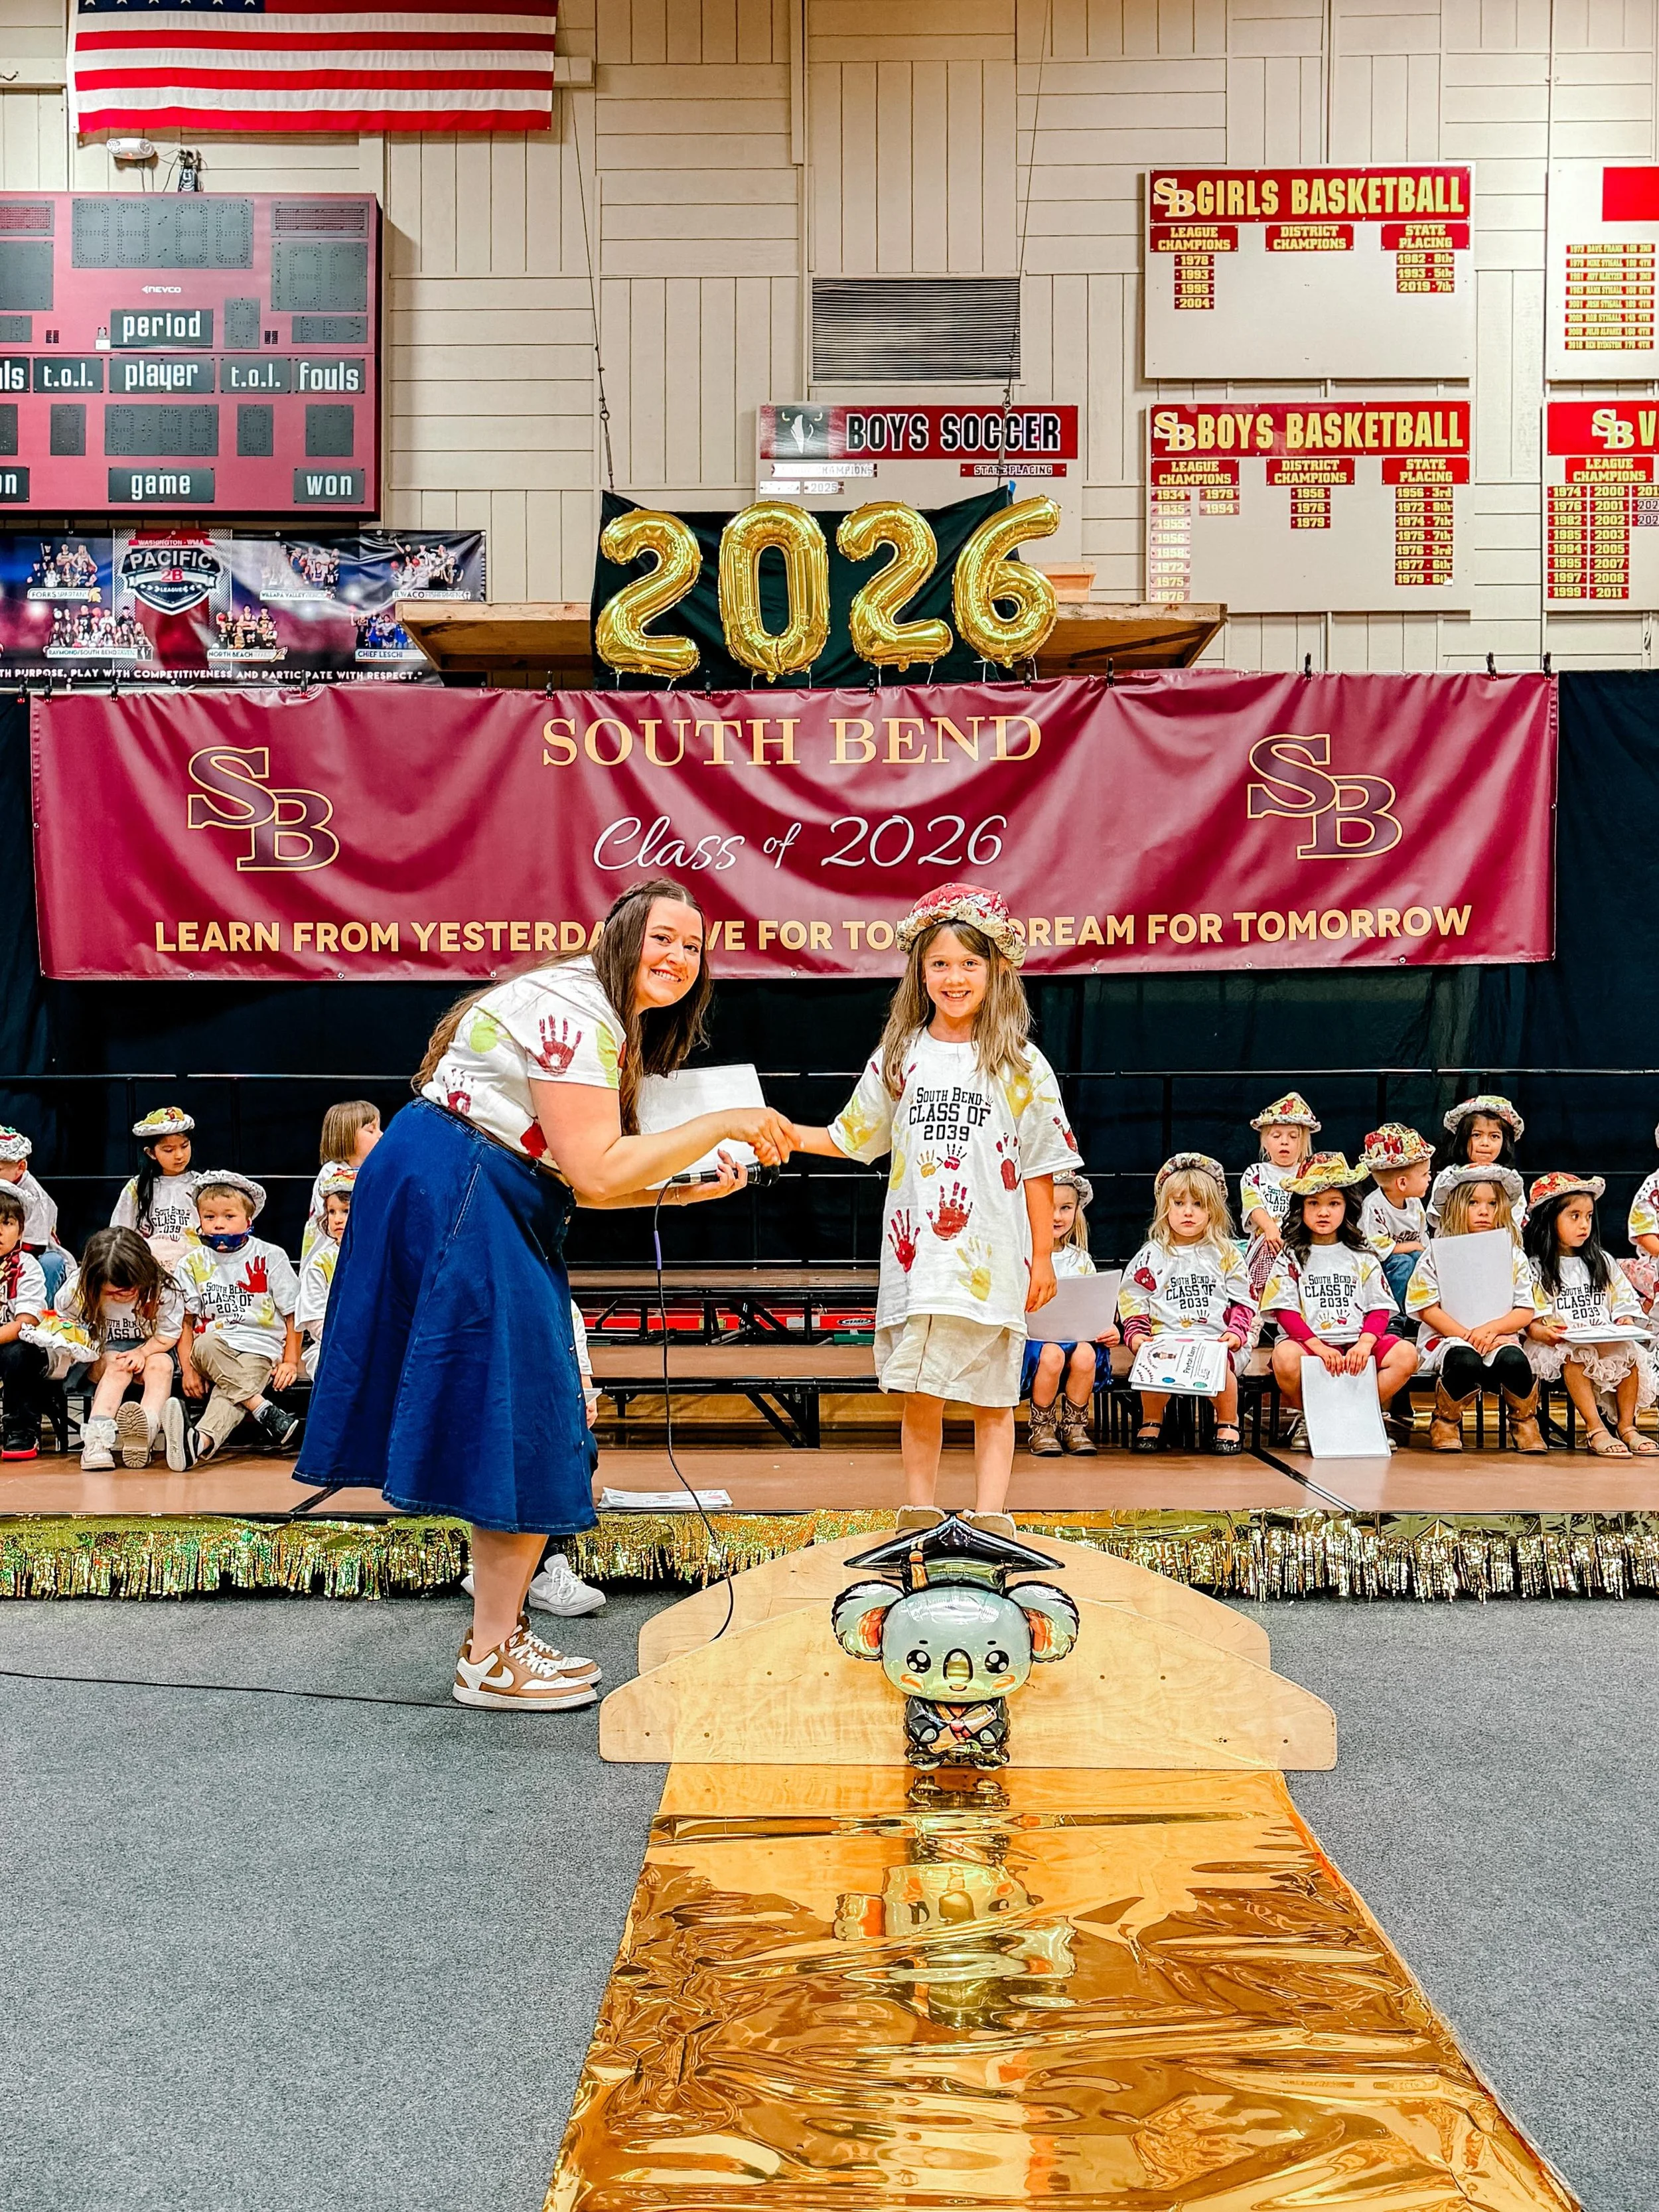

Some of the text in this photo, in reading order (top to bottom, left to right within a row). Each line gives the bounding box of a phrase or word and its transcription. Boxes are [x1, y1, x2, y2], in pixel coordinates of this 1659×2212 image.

[1196, 179, 1279, 215] GIRLS
[1291, 177, 1464, 214] BASKETBALL
[1171, 227, 1218, 238] LEAGUE
[1280, 226, 1339, 237] DISTRICT
[1406, 224, 1446, 236] STATE
[1158, 240, 1230, 251] CHAMPIONS
[1273, 238, 1346, 250] CHAMPIONS
[1399, 237, 1453, 249] PLACING
[1181, 256, 1208, 265] 1978
[1181, 269, 1209, 279] 1993
[1181, 284, 1209, 294] 1995
[1400, 281, 1451, 291] 2019 7th
[1179, 298, 1210, 308] 2004
[123, 311, 200, 342] period
[43, 362, 94, 387] t.o.l.
[125, 360, 198, 390] player
[231, 363, 281, 388] t.o.l.
[299, 362, 359, 390] fouls
[846, 413, 1062, 451] BOYS SOCCER
[1197, 413, 1273, 449] BOYS
[1286, 411, 1463, 448] BASKETBALL
[1171, 461, 1219, 472] LEAGUE
[1281, 459, 1340, 471] DISTRICT
[1406, 459, 1446, 470] STATE
[1585, 457, 1634, 470] LEAGUE
[818, 466, 873, 475] HAMPIONS
[974, 465, 1052, 475] STATE PLACING
[1159, 473, 1232, 485] CHAMPIONS
[1274, 472, 1347, 484] CHAMPIONS
[1400, 471, 1453, 483] PLACING
[1573, 471, 1646, 482] CHAMPIONS
[131, 474, 191, 500] game
[306, 474, 352, 496] won
[811, 482, 837, 492] 2025
[1157, 490, 1185, 500] 1934
[1205, 489, 1234, 499] 1979
[1297, 488, 1325, 498] 1956
[1398, 487, 1451, 497] 1956 3rd
[1553, 486, 1582, 496] 1974
[1594, 486, 1625, 496] 2000
[1637, 486, 1659, 496] 201
[1297, 502, 1325, 512] 1976
[1398, 502, 1425, 512] 1972
[1553, 501, 1582, 512] 1976
[1594, 500, 1625, 511] 2001
[1638, 500, 1658, 510] 202
[1297, 517, 1325, 528] 1979
[1398, 516, 1451, 526] 1974 7th
[1553, 515, 1582, 526] 1982
[1594, 515, 1625, 526] 2002
[1638, 515, 1658, 524] 202
[1398, 530, 1451, 541] 1975 7th
[1594, 529, 1625, 540] 2003
[1398, 545, 1451, 555] 1976 3rd
[1594, 544, 1625, 554] 2005
[130, 550, 213, 569] PACIFIC
[1398, 559, 1425, 569] 1977
[1553, 557, 1582, 568] 1995
[1594, 558, 1625, 569] 2007
[161, 569, 183, 583] 2B
[1398, 574, 1425, 584] 1979
[1553, 572, 1582, 583] 1997
[1594, 573, 1625, 583] 2008
[595, 494, 1063, 682] 2026
[1553, 587, 1582, 597] 1999
[1595, 587, 1623, 598] 2011
[15, 668, 67, 678] PURPOSE,
[70, 668, 99, 678] PLAY
[103, 669, 130, 678] WITH
[134, 669, 233, 679] COMPETITIVENESS
[236, 670, 258, 679] AND
[261, 670, 332, 680] PARTICPATE
[336, 671, 364, 680] WITH
[542, 715, 1042, 769] SOUTH BEND
[1248, 733, 1404, 860] SB
[187, 745, 340, 872] SB
[592, 814, 1007, 871] Class of 2026
[155, 921, 279, 953] LEARN
[293, 921, 399, 952] FROM
[413, 921, 607, 952] YESTERDA
[705, 920, 746, 952] VE
[758, 920, 833, 950] FOR
[1147, 913, 1223, 946] FOR
[1232, 905, 1472, 943] TOMORROW
[916, 1087, 982, 1106] SOUTH BEND
[909, 1102, 991, 1127] CLASS OF
[924, 1124, 970, 1142] 2039
[1190, 1274, 1209, 1284] BEND
[1309, 1274, 1351, 1285] SOUTH BEND
[206, 1282, 227, 1294] SOUTH
[1166, 1284, 1216, 1301] CLASS OF
[1305, 1284, 1356, 1297] CLASS OF
[1561, 1286, 1583, 1297] SOUTH
[202, 1293, 254, 1306] CLASS OF
[1179, 1297, 1209, 1309] 2039
[1320, 1297, 1349, 1307] 2039
[1557, 1293, 1591, 1310] CLASS
[1572, 1307, 1601, 1319] 2039
